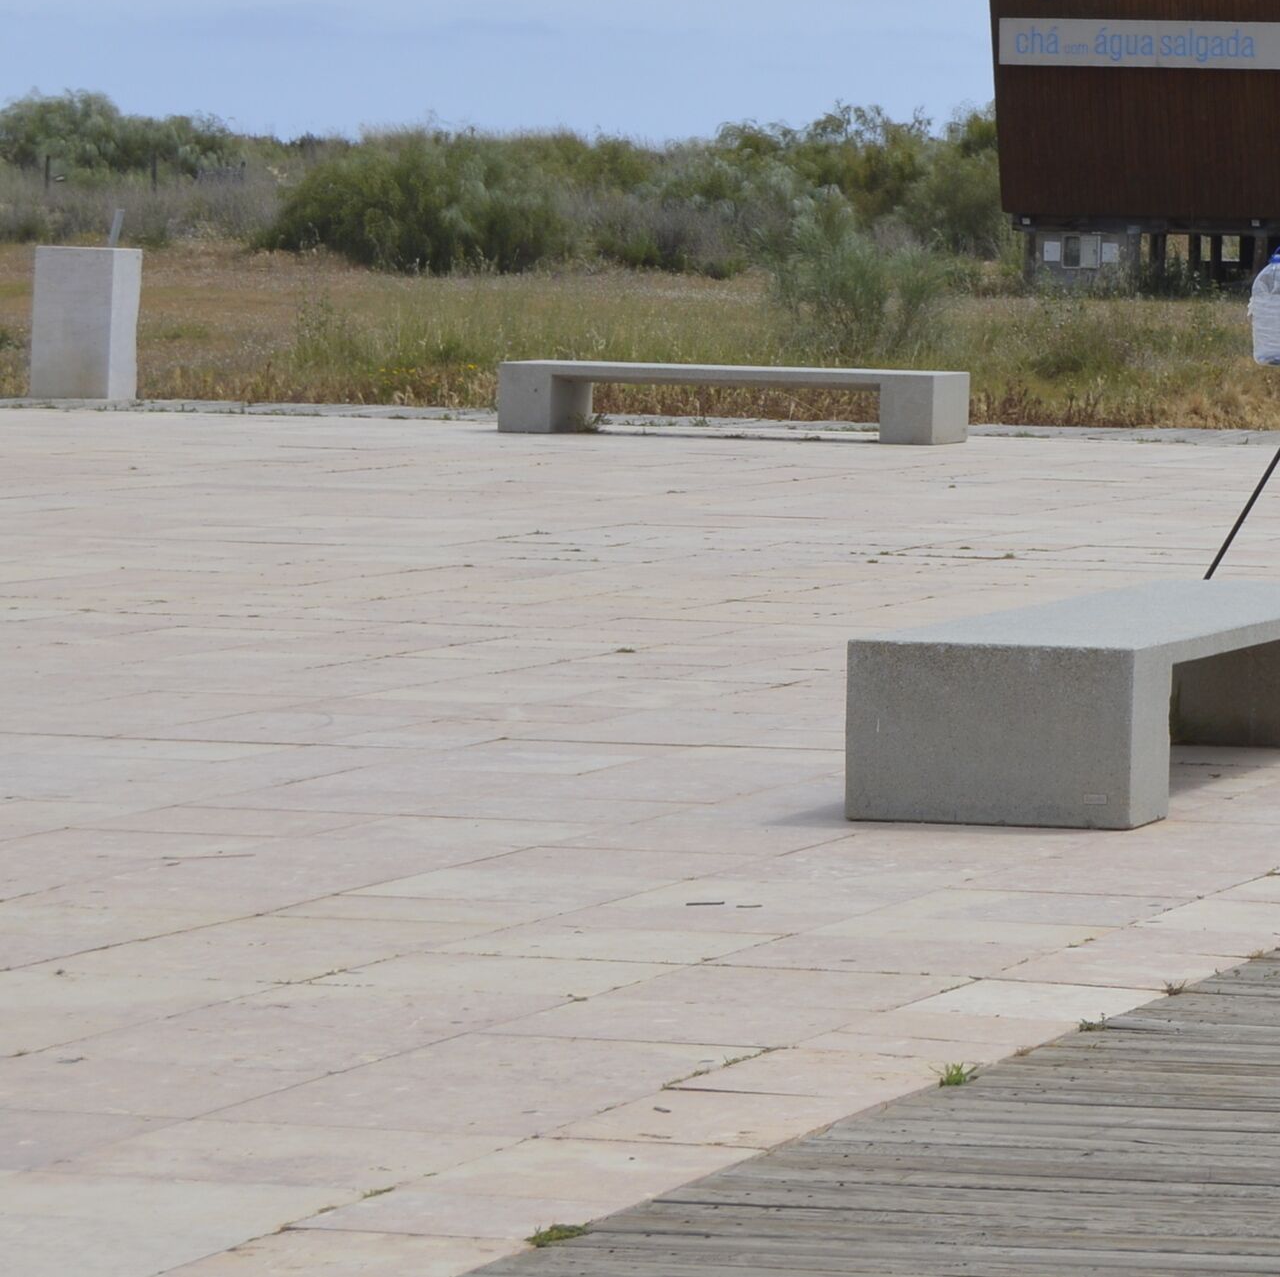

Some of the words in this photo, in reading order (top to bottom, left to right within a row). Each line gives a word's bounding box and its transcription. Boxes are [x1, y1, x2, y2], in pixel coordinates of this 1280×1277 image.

[1016, 26, 1059, 55] chá
[1094, 27, 1154, 62] água
[1160, 28, 1255, 63] salgada
